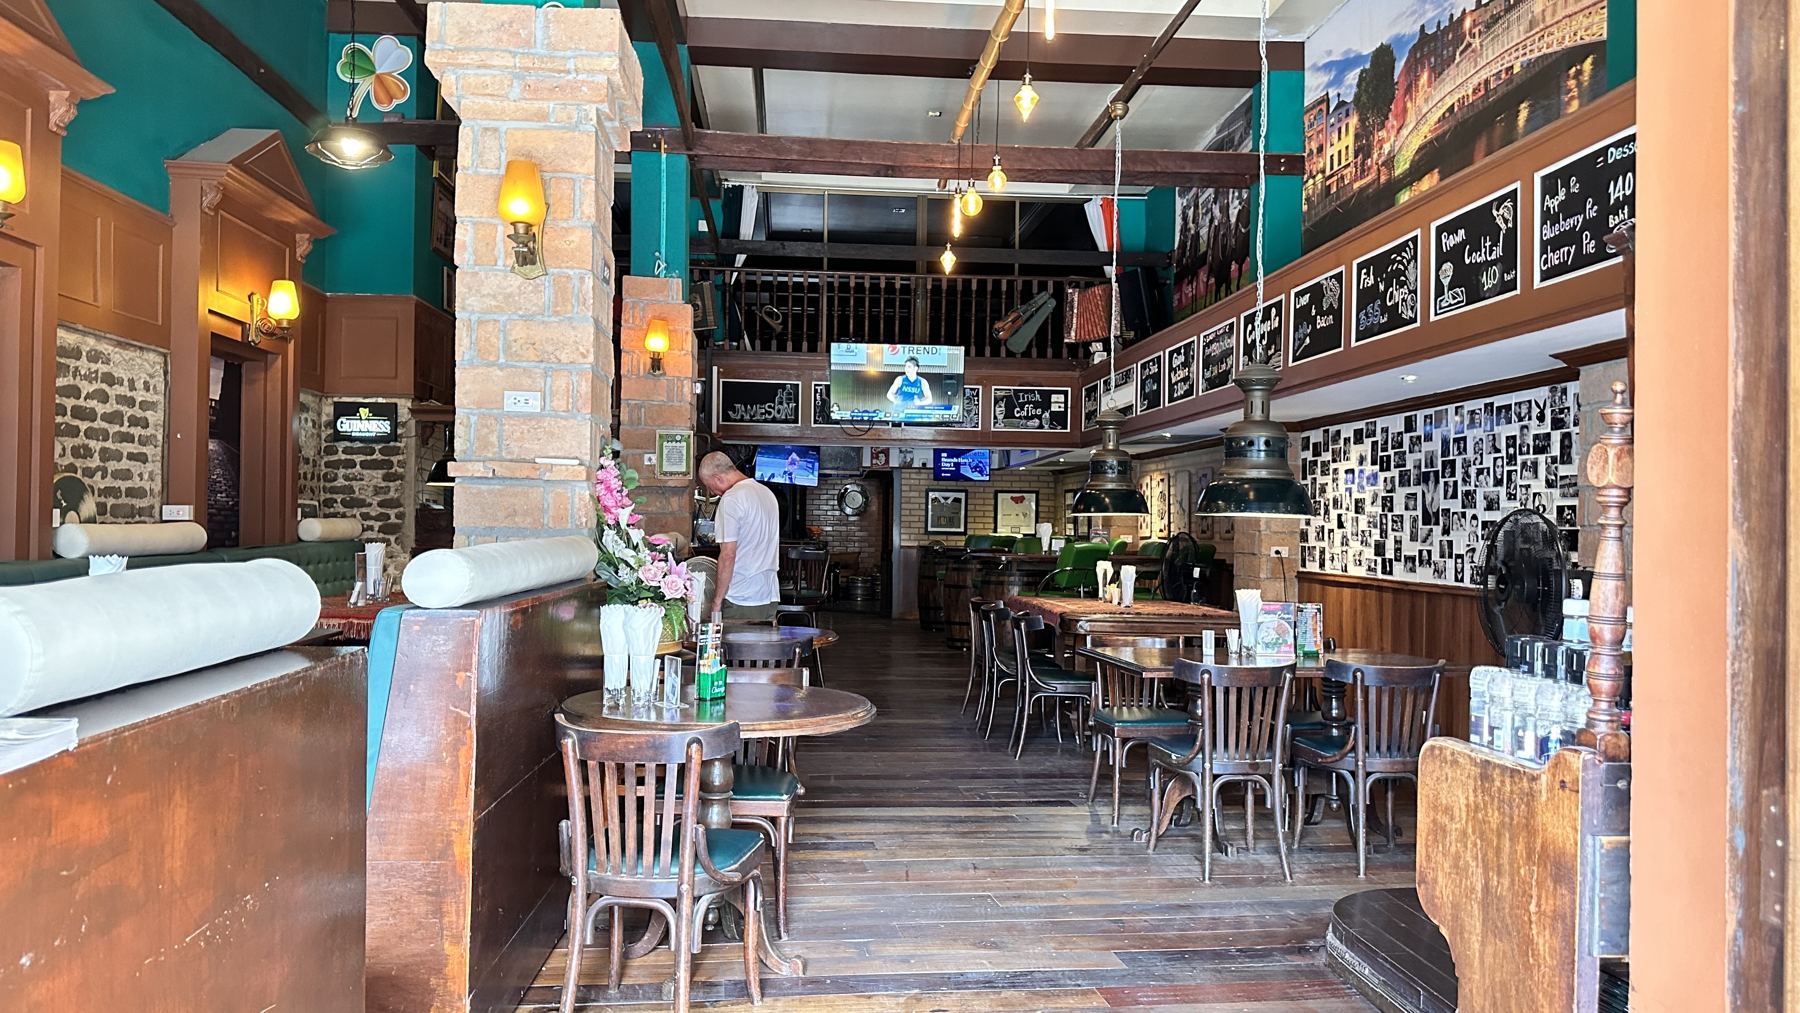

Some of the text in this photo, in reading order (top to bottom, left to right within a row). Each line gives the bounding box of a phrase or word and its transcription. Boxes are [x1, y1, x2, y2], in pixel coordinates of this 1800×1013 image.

[1543, 176, 1580, 214] Apple Pie
[1608, 172, 1634, 206] 140
[1542, 197, 1598, 241] Blueberry Pie
[1608, 205, 1628, 228] Baht
[1442, 228, 1466, 253] Prawn
[1464, 230, 1504, 265] Cocktail
[1582, 231, 1596, 255] Pie
[1360, 265, 1375, 290] Fish
[1481, 265, 1499, 291] 160
[1296, 292, 1311, 309] Liver
[1386, 278, 1409, 314] Chips
[1316, 315, 1334, 330] Bacon
[901, 345, 938, 356] TREND
[1017, 390, 1042, 403] Irish
[727, 402, 797, 420] JAMESON
[1014, 404, 1042, 418] Coffee
